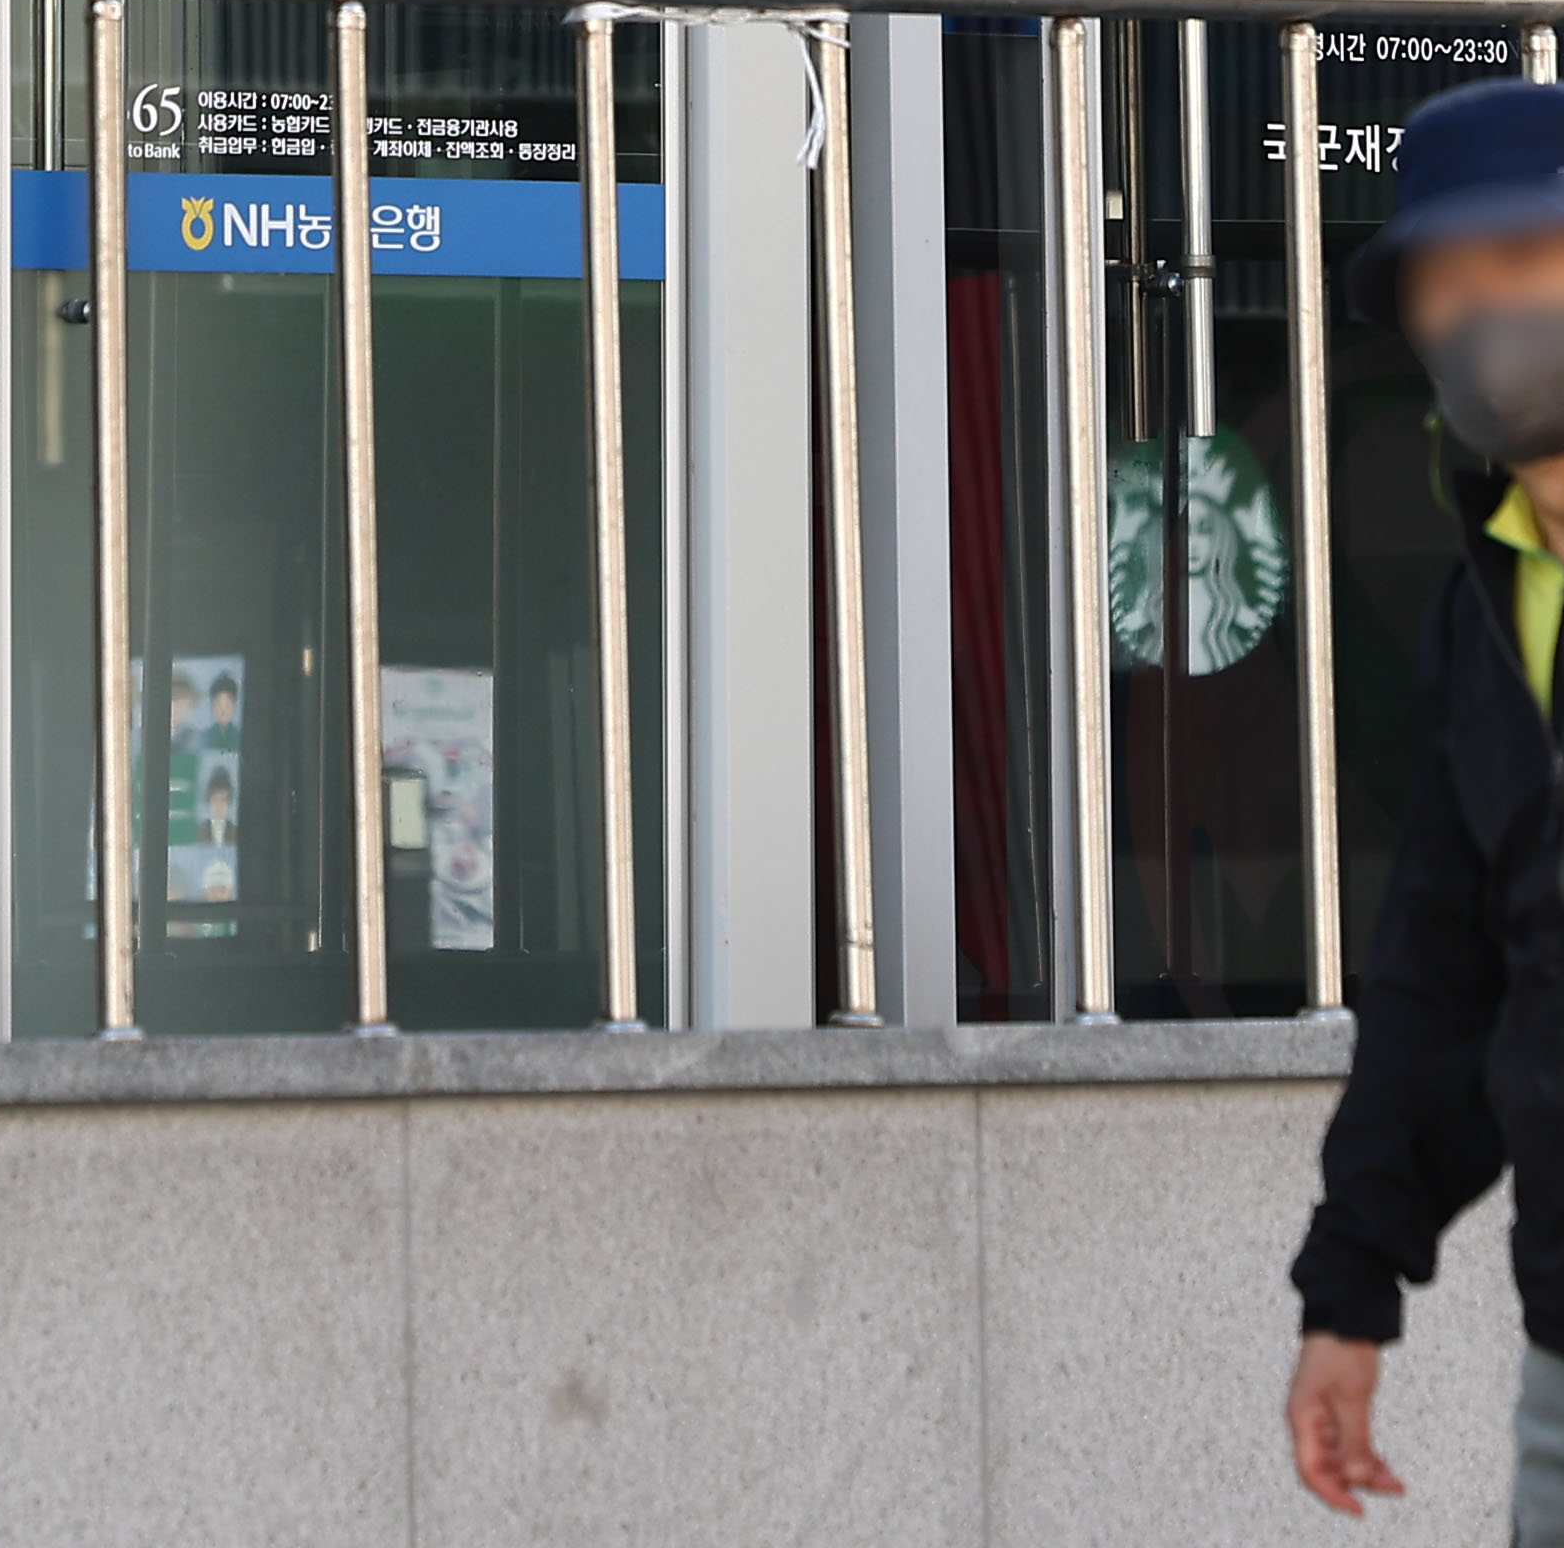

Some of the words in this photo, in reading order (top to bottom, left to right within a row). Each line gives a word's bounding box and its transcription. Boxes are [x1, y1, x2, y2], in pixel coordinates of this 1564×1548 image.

[1376, 36, 1508, 64] 07:00~23:30
[127, 83, 182, 137] 65
[197, 91, 257, 110] 이용시간
[197, 114, 257, 132] 사용카드
[270, 115, 331, 134] 농협카드
[416, 118, 519, 138] 전금융기관사용
[144, 143, 181, 159] Bank
[198, 135, 257, 155] 취급업무
[372, 140, 432, 158] 계좌이체
[445, 141, 504, 160] 잔액조회
[518, 142, 576, 161] 통장정리
